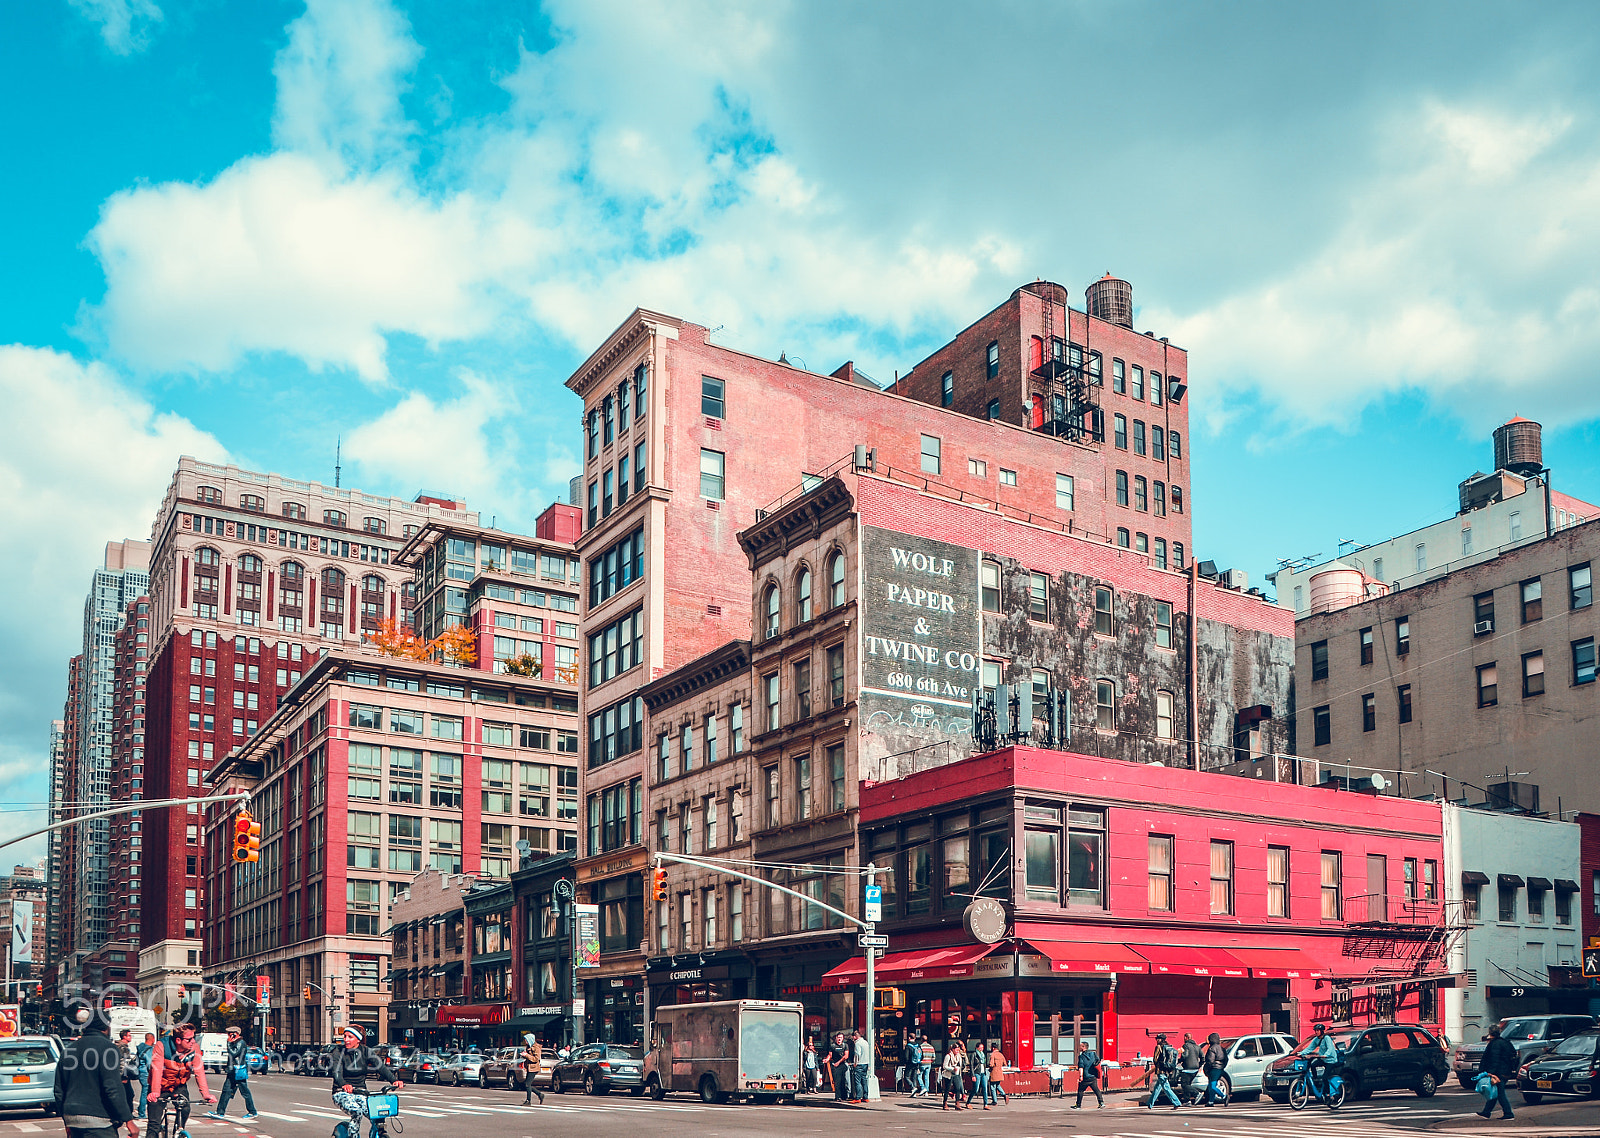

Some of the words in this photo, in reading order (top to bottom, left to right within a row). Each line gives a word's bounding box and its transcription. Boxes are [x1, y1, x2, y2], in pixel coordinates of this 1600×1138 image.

[889, 546, 955, 578] WOLF
[887, 583, 956, 614] PAPER
[913, 616, 931, 636] &
[865, 636, 940, 666] TWINE
[944, 650, 980, 672] CO.
[887, 671, 913, 689] 680
[916, 676, 939, 693] 6th
[942, 681, 968, 698] Ave
[590, 865, 605, 876] HALL
[606, 857, 633, 873] BUILDING
[975, 902, 1003, 917] MARKT
[673, 969, 702, 980] CHIPOTLE
[977, 963, 1009, 972] RESTAURANT
[1194, 967, 1209, 975] Markt
[1511, 988, 1525, 997] 59
